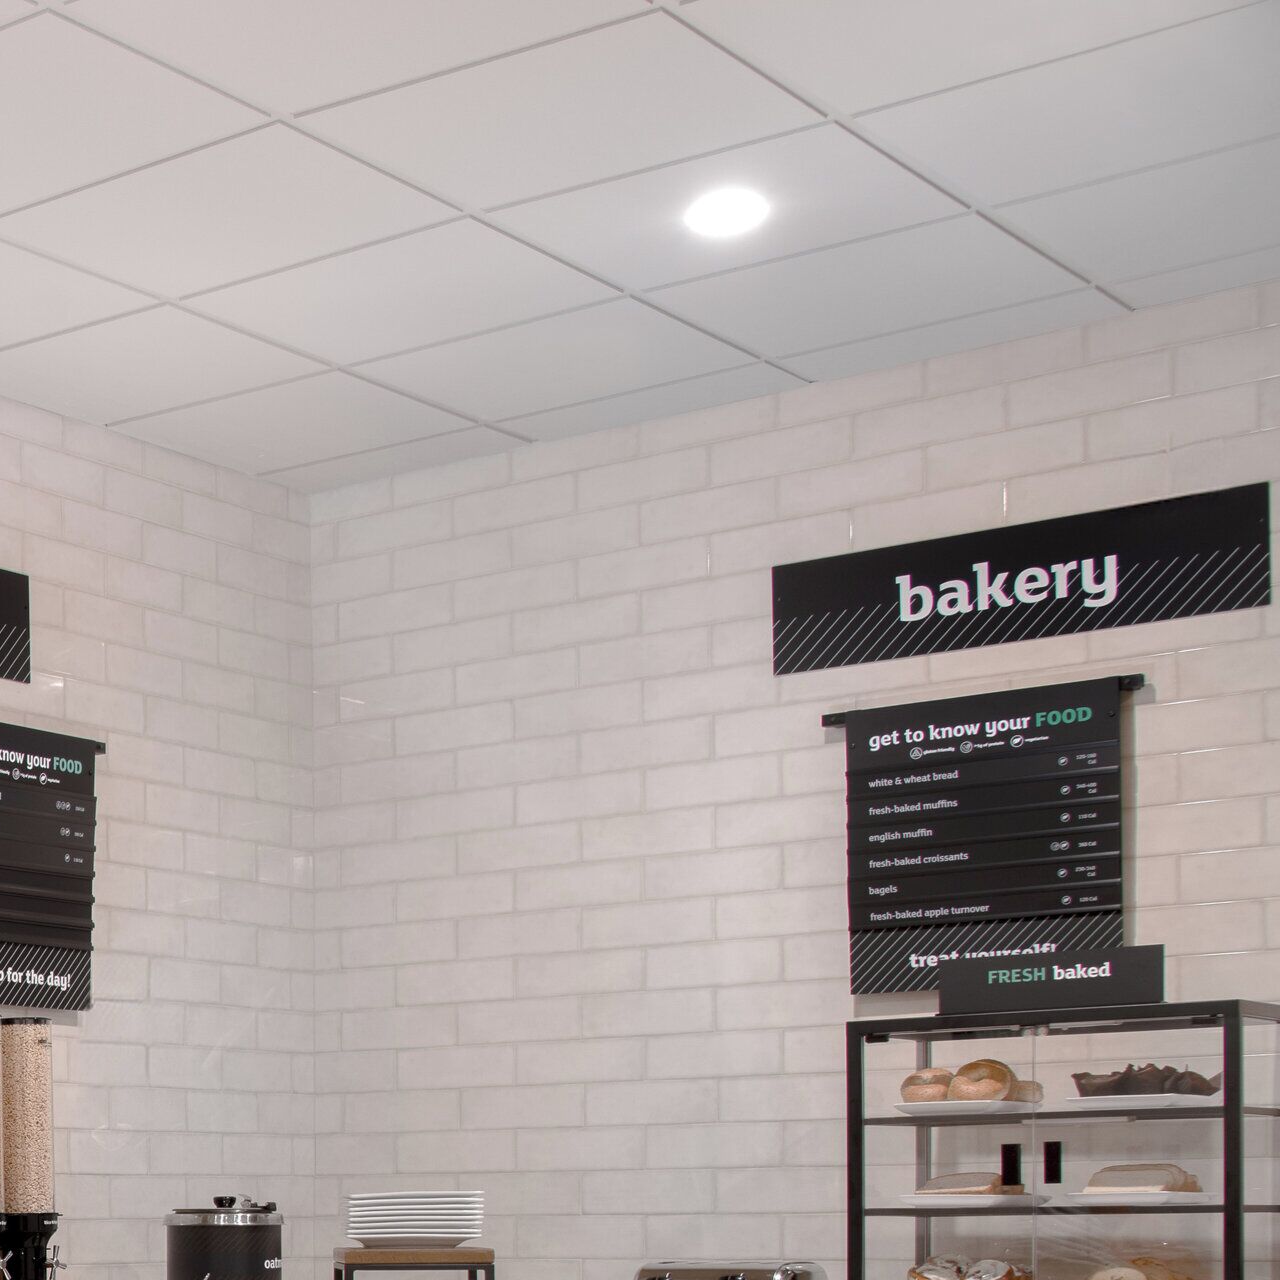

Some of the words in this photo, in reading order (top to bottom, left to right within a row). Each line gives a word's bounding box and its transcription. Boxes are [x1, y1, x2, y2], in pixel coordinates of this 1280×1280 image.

[895, 554, 1119, 622] bakery
[869, 731, 899, 751] get
[904, 728, 924, 744] to
[929, 722, 980, 741] know
[985, 714, 1031, 737] your
[1036, 707, 1092, 727] FOOD
[27, 753, 51, 770] your
[53, 757, 82, 775] FOOD
[868, 777, 892, 788] white
[895, 776, 902, 785] &
[904, 773, 931, 783] wheat
[933, 770, 958, 781] bread
[869, 802, 921, 816] fresh-baked
[922, 799, 958, 811] muffins
[868, 830, 901, 842] english
[902, 827, 932, 838] muffin
[869, 856, 921, 868] fresh-baked
[923, 852, 969, 864] croissants
[869, 885, 898, 897] bagels
[870, 908, 922, 921] fresh-baked
[924, 906, 949, 919] apple
[951, 903, 990, 915] turnover
[7, 967, 24, 983] for
[26, 970, 44, 985] the
[47, 971, 71, 991] day!
[988, 967, 1045, 984] FRESH
[1053, 962, 1111, 980] baked
